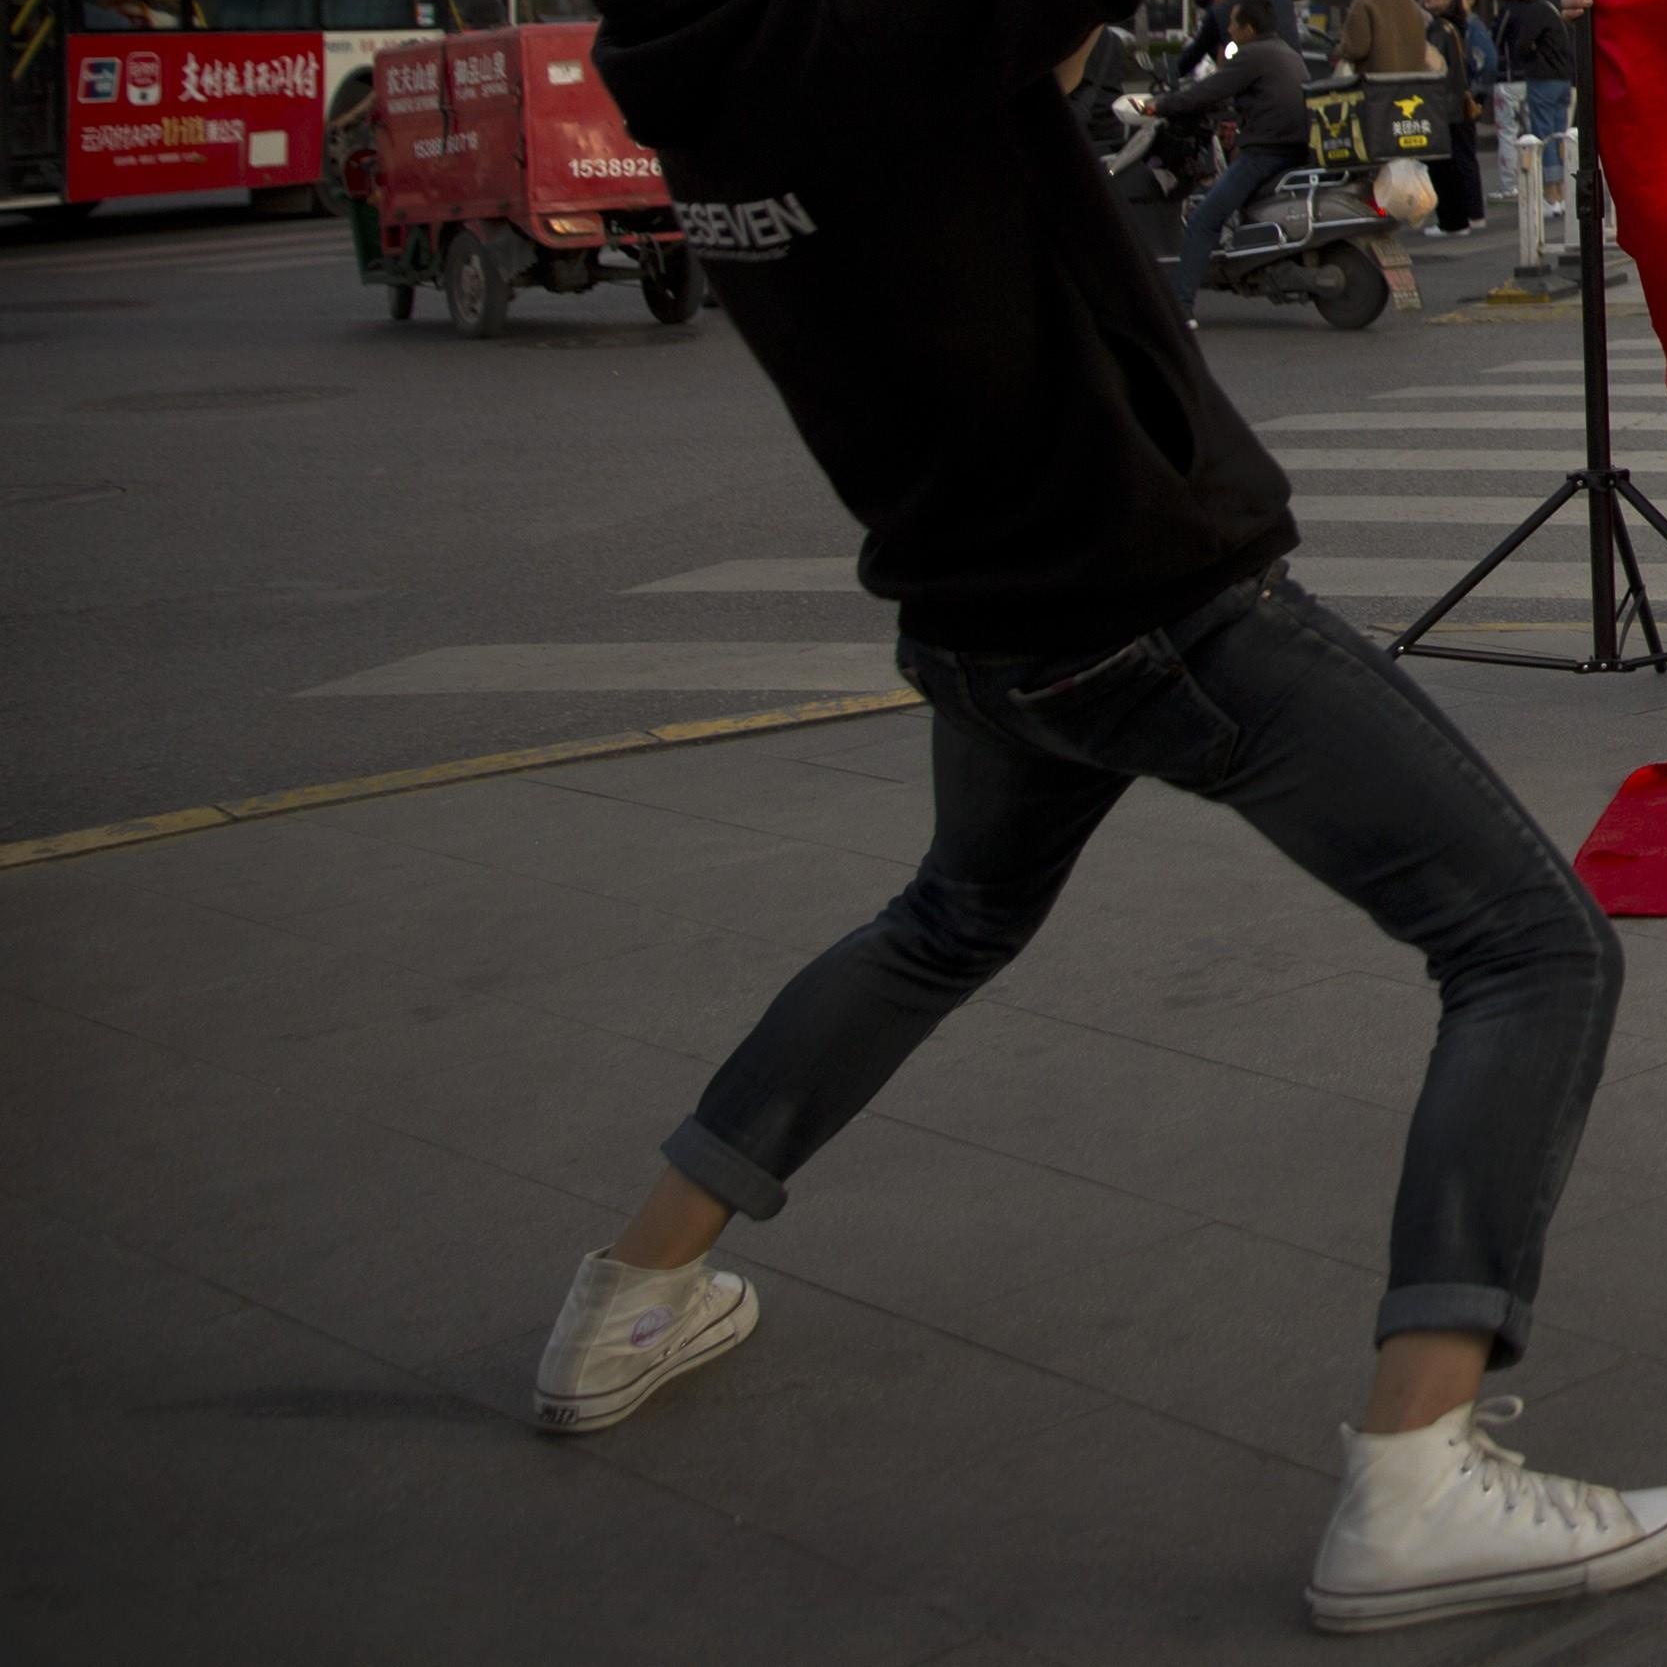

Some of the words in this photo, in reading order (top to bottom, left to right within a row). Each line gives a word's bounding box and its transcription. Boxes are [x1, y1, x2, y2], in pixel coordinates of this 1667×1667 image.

[1391, 119, 1432, 136] 美团外卖
[568, 157, 662, 179] 1538926
